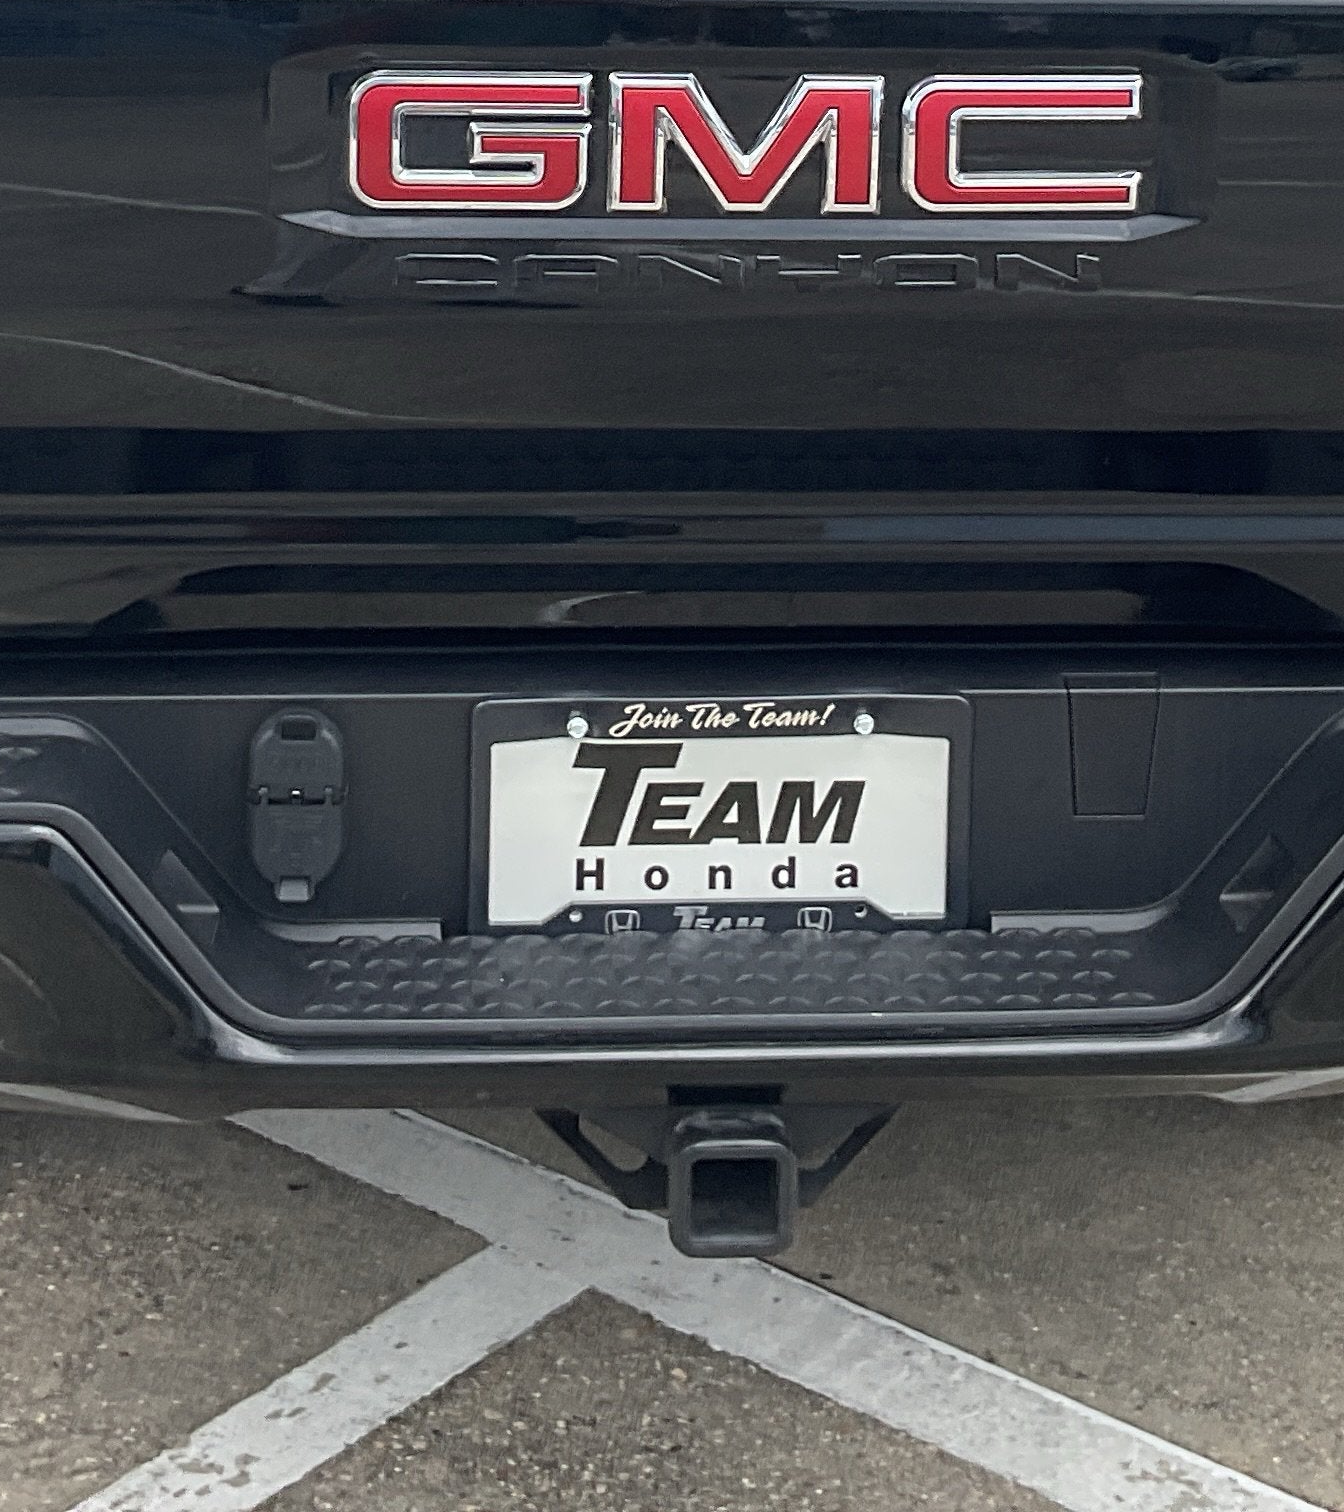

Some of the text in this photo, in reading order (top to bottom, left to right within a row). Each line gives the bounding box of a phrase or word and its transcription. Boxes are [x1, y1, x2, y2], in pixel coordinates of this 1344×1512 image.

[349, 70, 1144, 215] GMC
[608, 701, 837, 737] Join The Team!
[572, 741, 865, 847] TEAM
[574, 856, 860, 891] Honda
